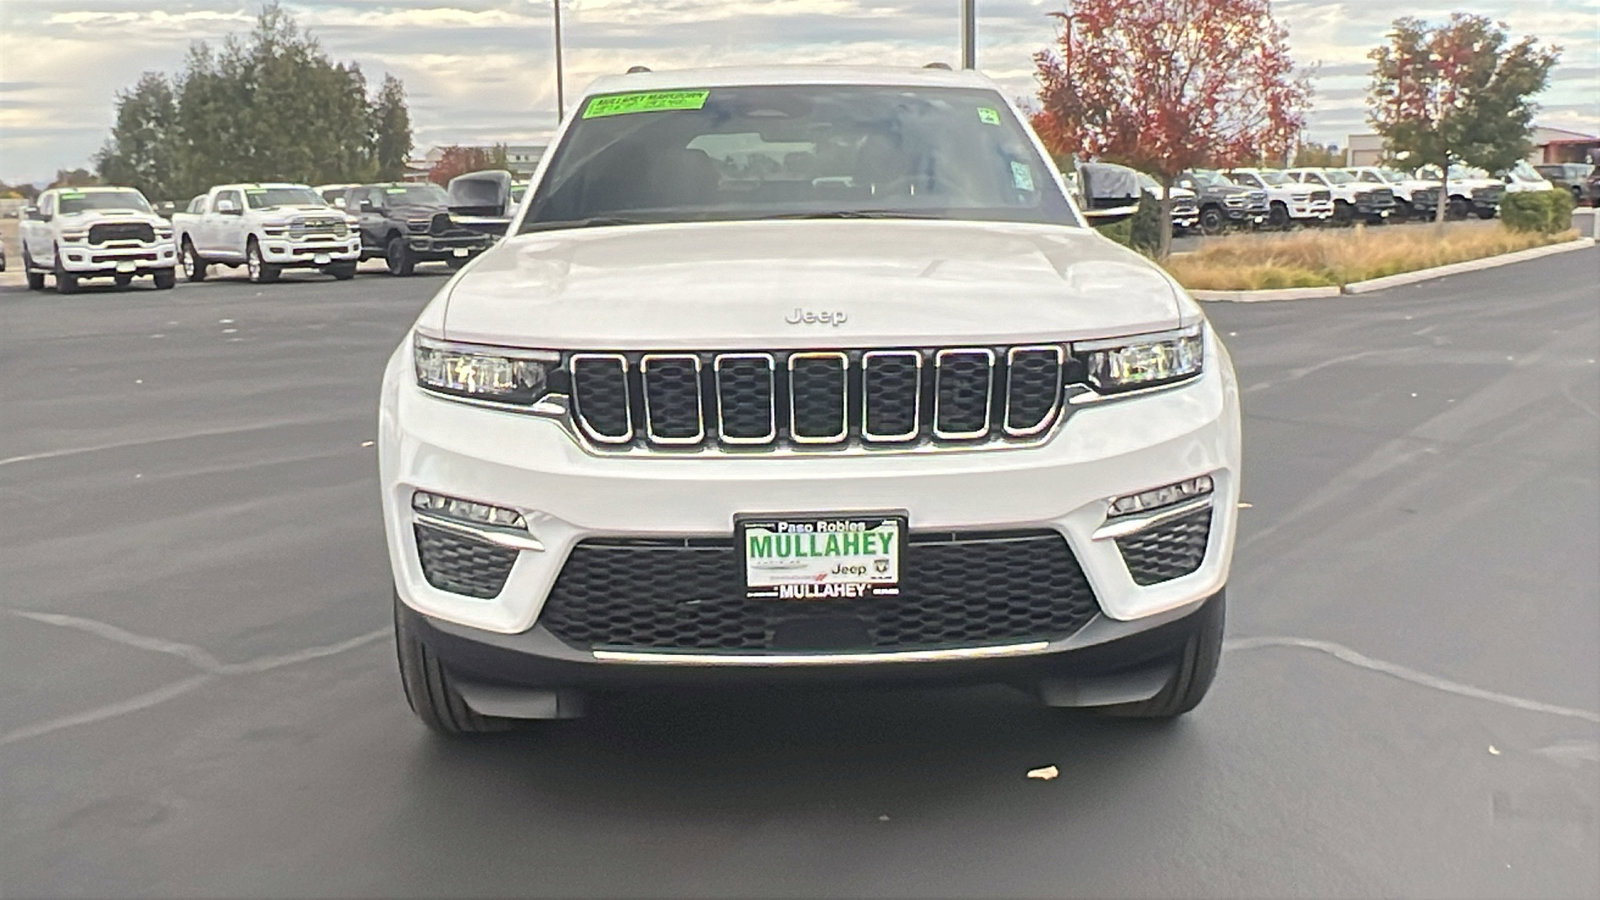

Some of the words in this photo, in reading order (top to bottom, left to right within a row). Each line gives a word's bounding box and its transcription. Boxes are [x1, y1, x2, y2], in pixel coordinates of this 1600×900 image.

[785, 308, 848, 327] Jeep
[778, 522, 812, 533] Paso
[817, 521, 866, 532] Robles
[750, 532, 894, 558] MULLAHEY
[832, 564, 867, 576] Jeep
[780, 584, 866, 599] MULLAHEY
